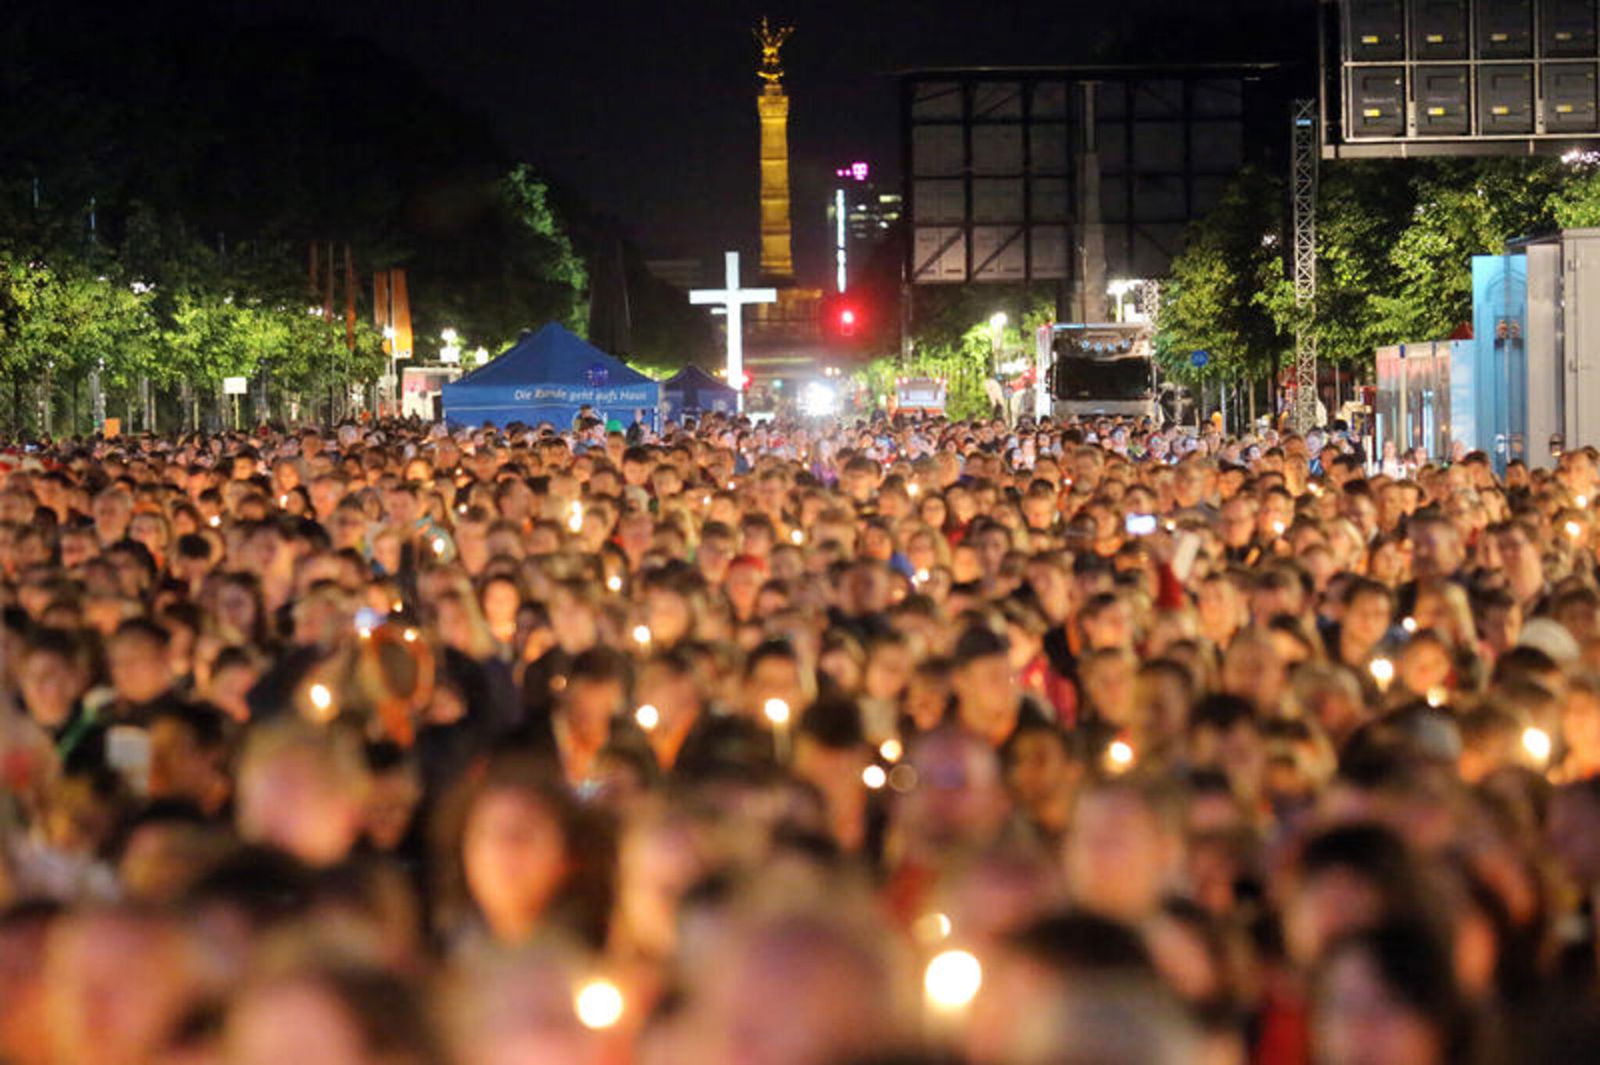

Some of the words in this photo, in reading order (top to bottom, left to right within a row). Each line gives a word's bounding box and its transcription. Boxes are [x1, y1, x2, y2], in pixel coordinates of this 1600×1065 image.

[514, 389, 532, 401] Die
[570, 389, 593, 402] geht
[619, 390, 647, 401] Haus
